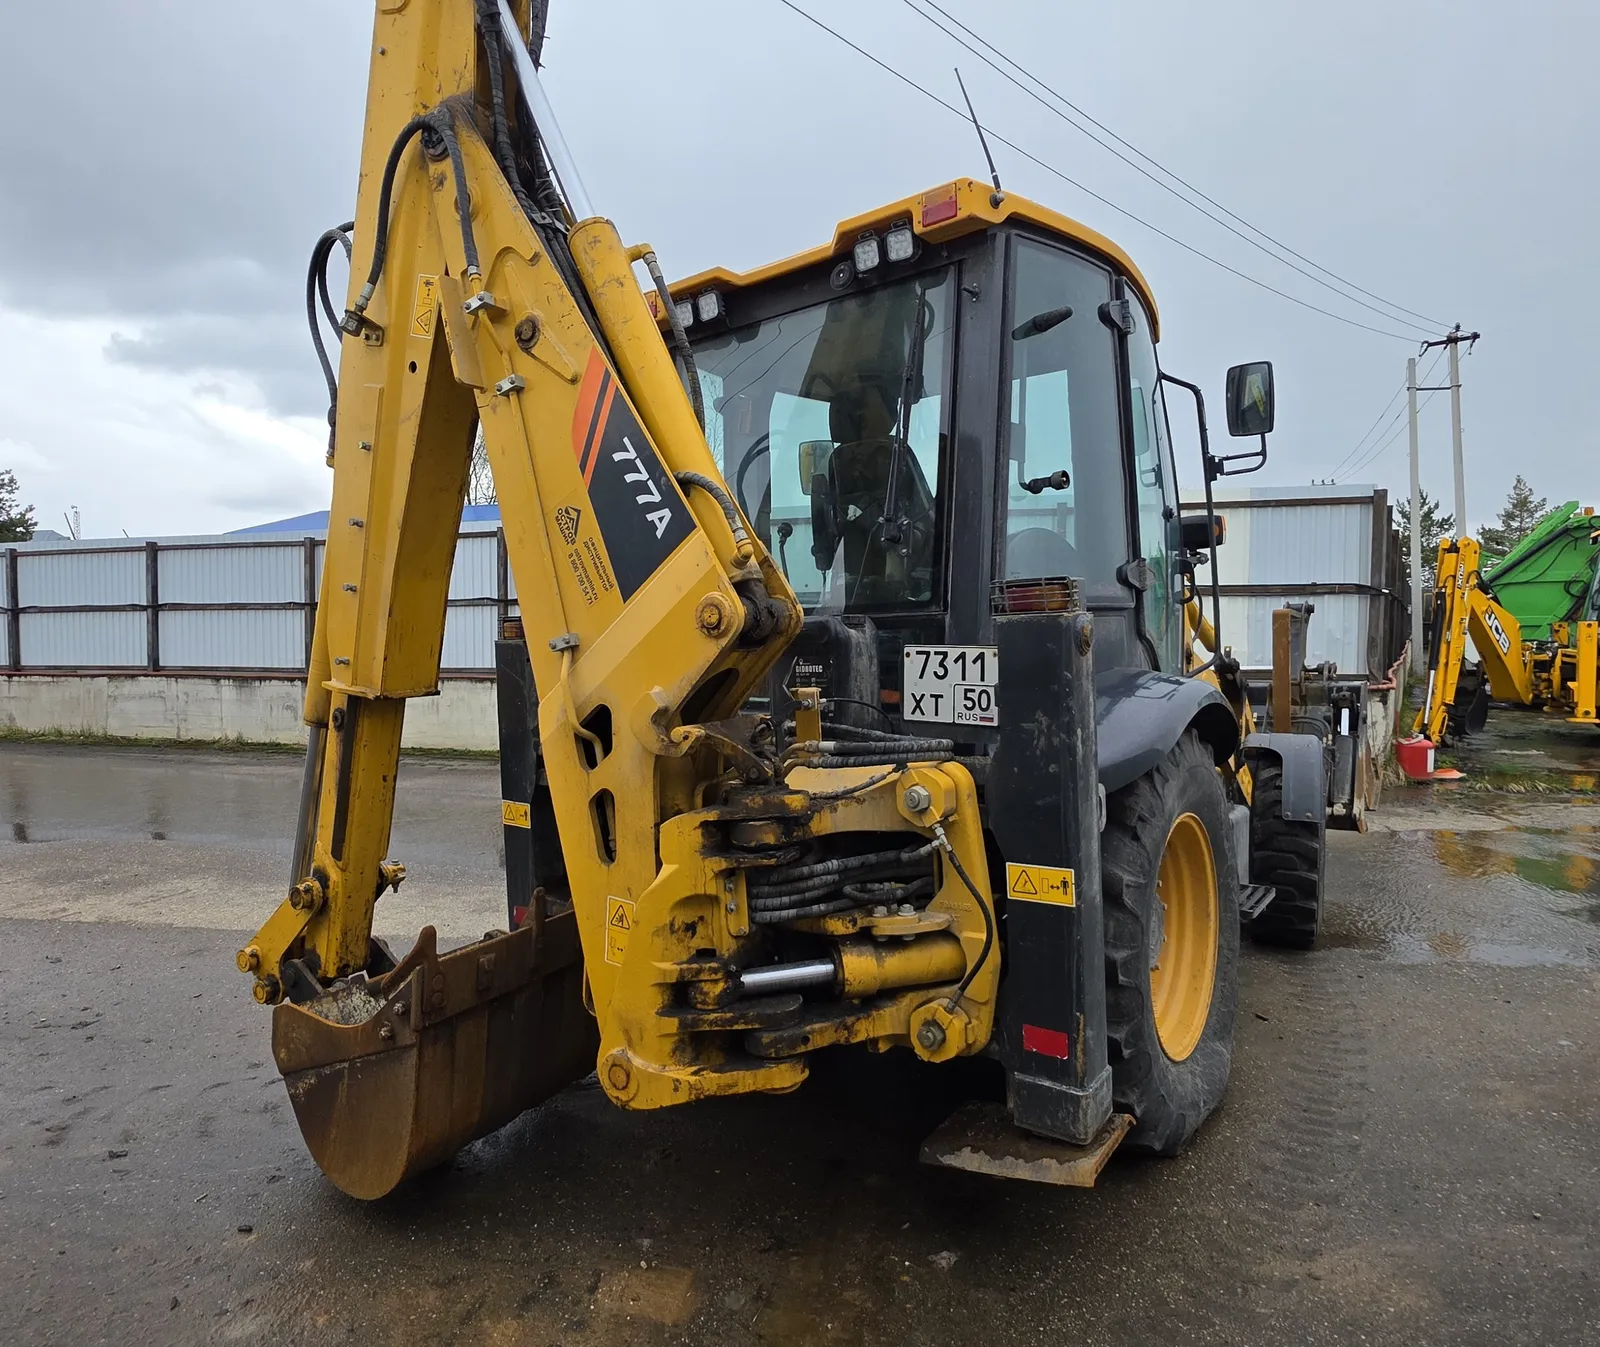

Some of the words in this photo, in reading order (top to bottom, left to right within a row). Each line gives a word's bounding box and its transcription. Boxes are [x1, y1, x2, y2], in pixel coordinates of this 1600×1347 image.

[612, 436, 672, 540] 777A
[555, 515, 570, 546] МАШИН
[557, 508, 576, 546] ОСТРОВ
[573, 548, 599, 601] ostrovmashin.ru
[576, 573, 586, 588] 700
[582, 540, 609, 592] ДИСТРИБЬЮТОР
[588, 536, 615, 590] ОФИЦИАЛЬНЫЙ
[1484, 611, 1510, 654] JCB
[915, 650, 985, 682] 7311
[957, 712, 979, 721] RUS
[963, 688, 991, 712] 50
